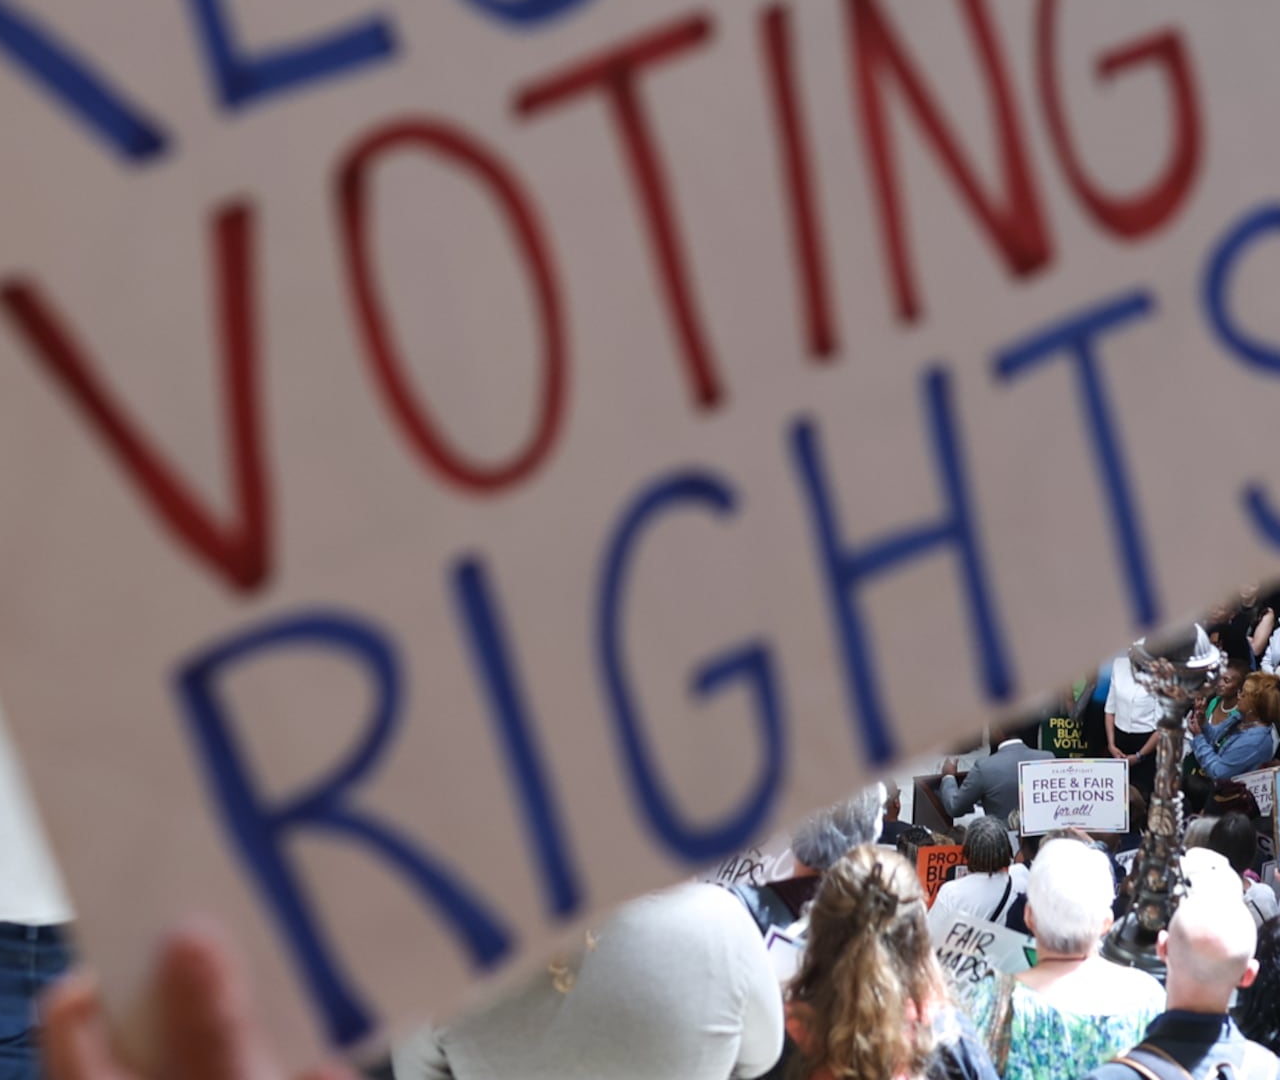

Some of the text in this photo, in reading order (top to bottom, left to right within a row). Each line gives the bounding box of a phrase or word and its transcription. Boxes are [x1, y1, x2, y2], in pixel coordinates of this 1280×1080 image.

[1057, 728, 1082, 739] BLA
[1032, 776, 1115, 791] FREE & FAIR
[1032, 789, 1116, 805] ELECTIONS
[1053, 802, 1094, 820] for all!
[717, 855, 764, 889] APS
[944, 922, 995, 957] FAIR
